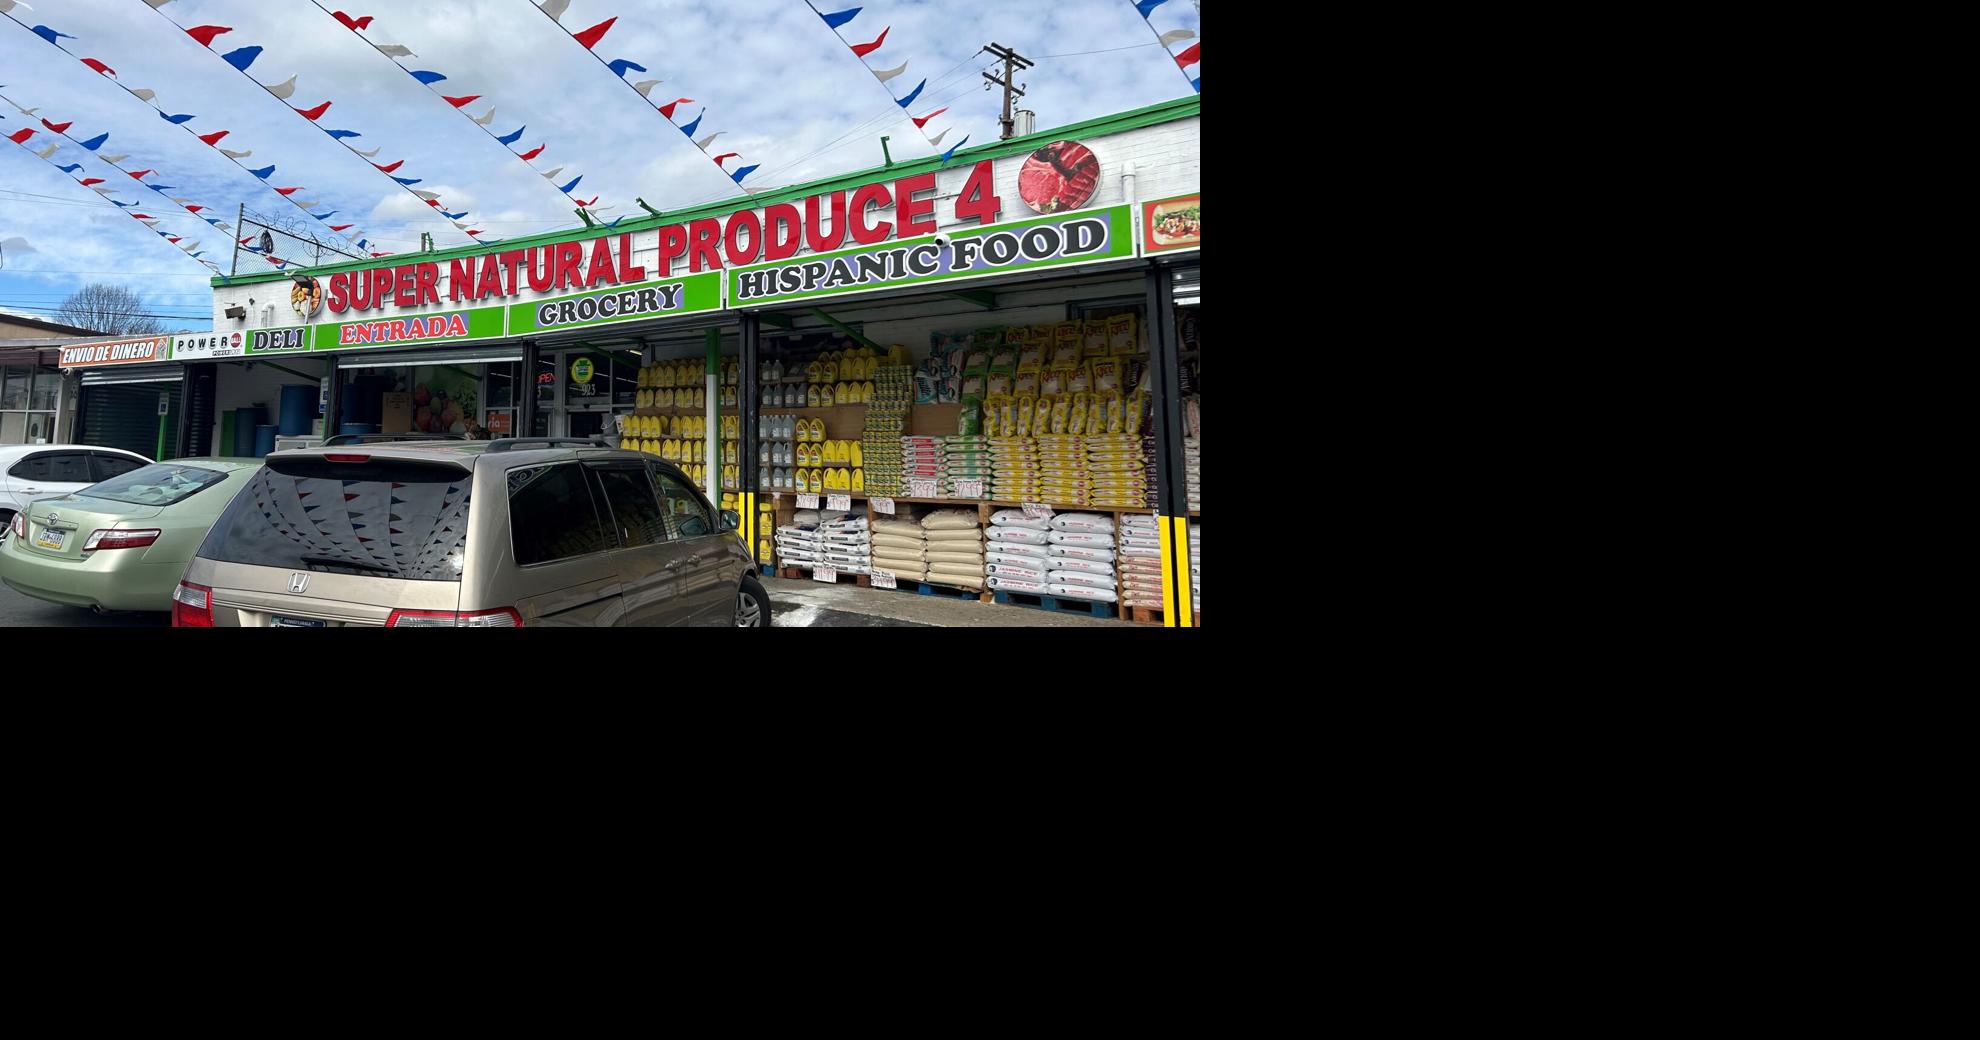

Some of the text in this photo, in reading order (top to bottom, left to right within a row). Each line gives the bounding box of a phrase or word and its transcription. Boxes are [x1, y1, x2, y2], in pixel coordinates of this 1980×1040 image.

[328, 159, 1001, 314] SUPER NATURAL PRODUCE 4
[738, 218, 1108, 300] HISPANIC FOOD
[539, 283, 682, 326] GROCERY
[252, 329, 305, 352] DELI
[340, 314, 468, 344] ENTRADA
[63, 341, 154, 364] ENVIO DE DINERO
[177, 336, 228, 350] POWER
[581, 384, 596, 397] 923
